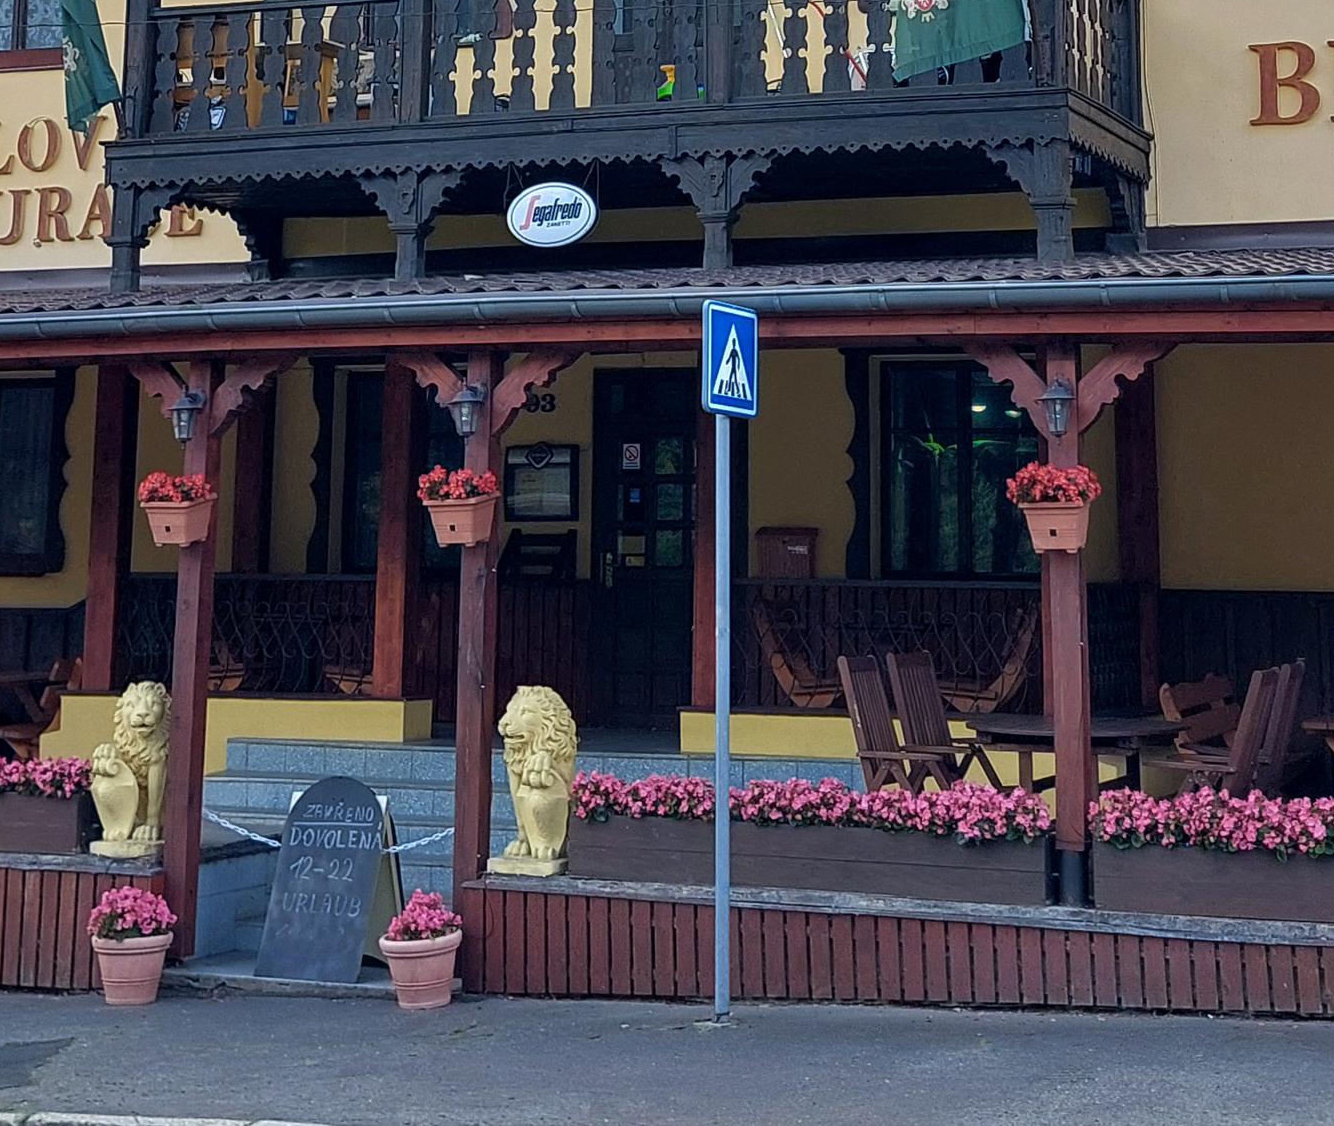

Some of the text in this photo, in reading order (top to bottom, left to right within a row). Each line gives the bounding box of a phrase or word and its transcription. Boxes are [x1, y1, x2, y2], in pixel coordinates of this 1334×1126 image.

[519, 194, 583, 231] Segafredo
[303, 801, 374, 822] ZAVŘENO
[289, 821, 384, 850] DOVOLENÁ
[282, 892, 362, 917] URLAUB
